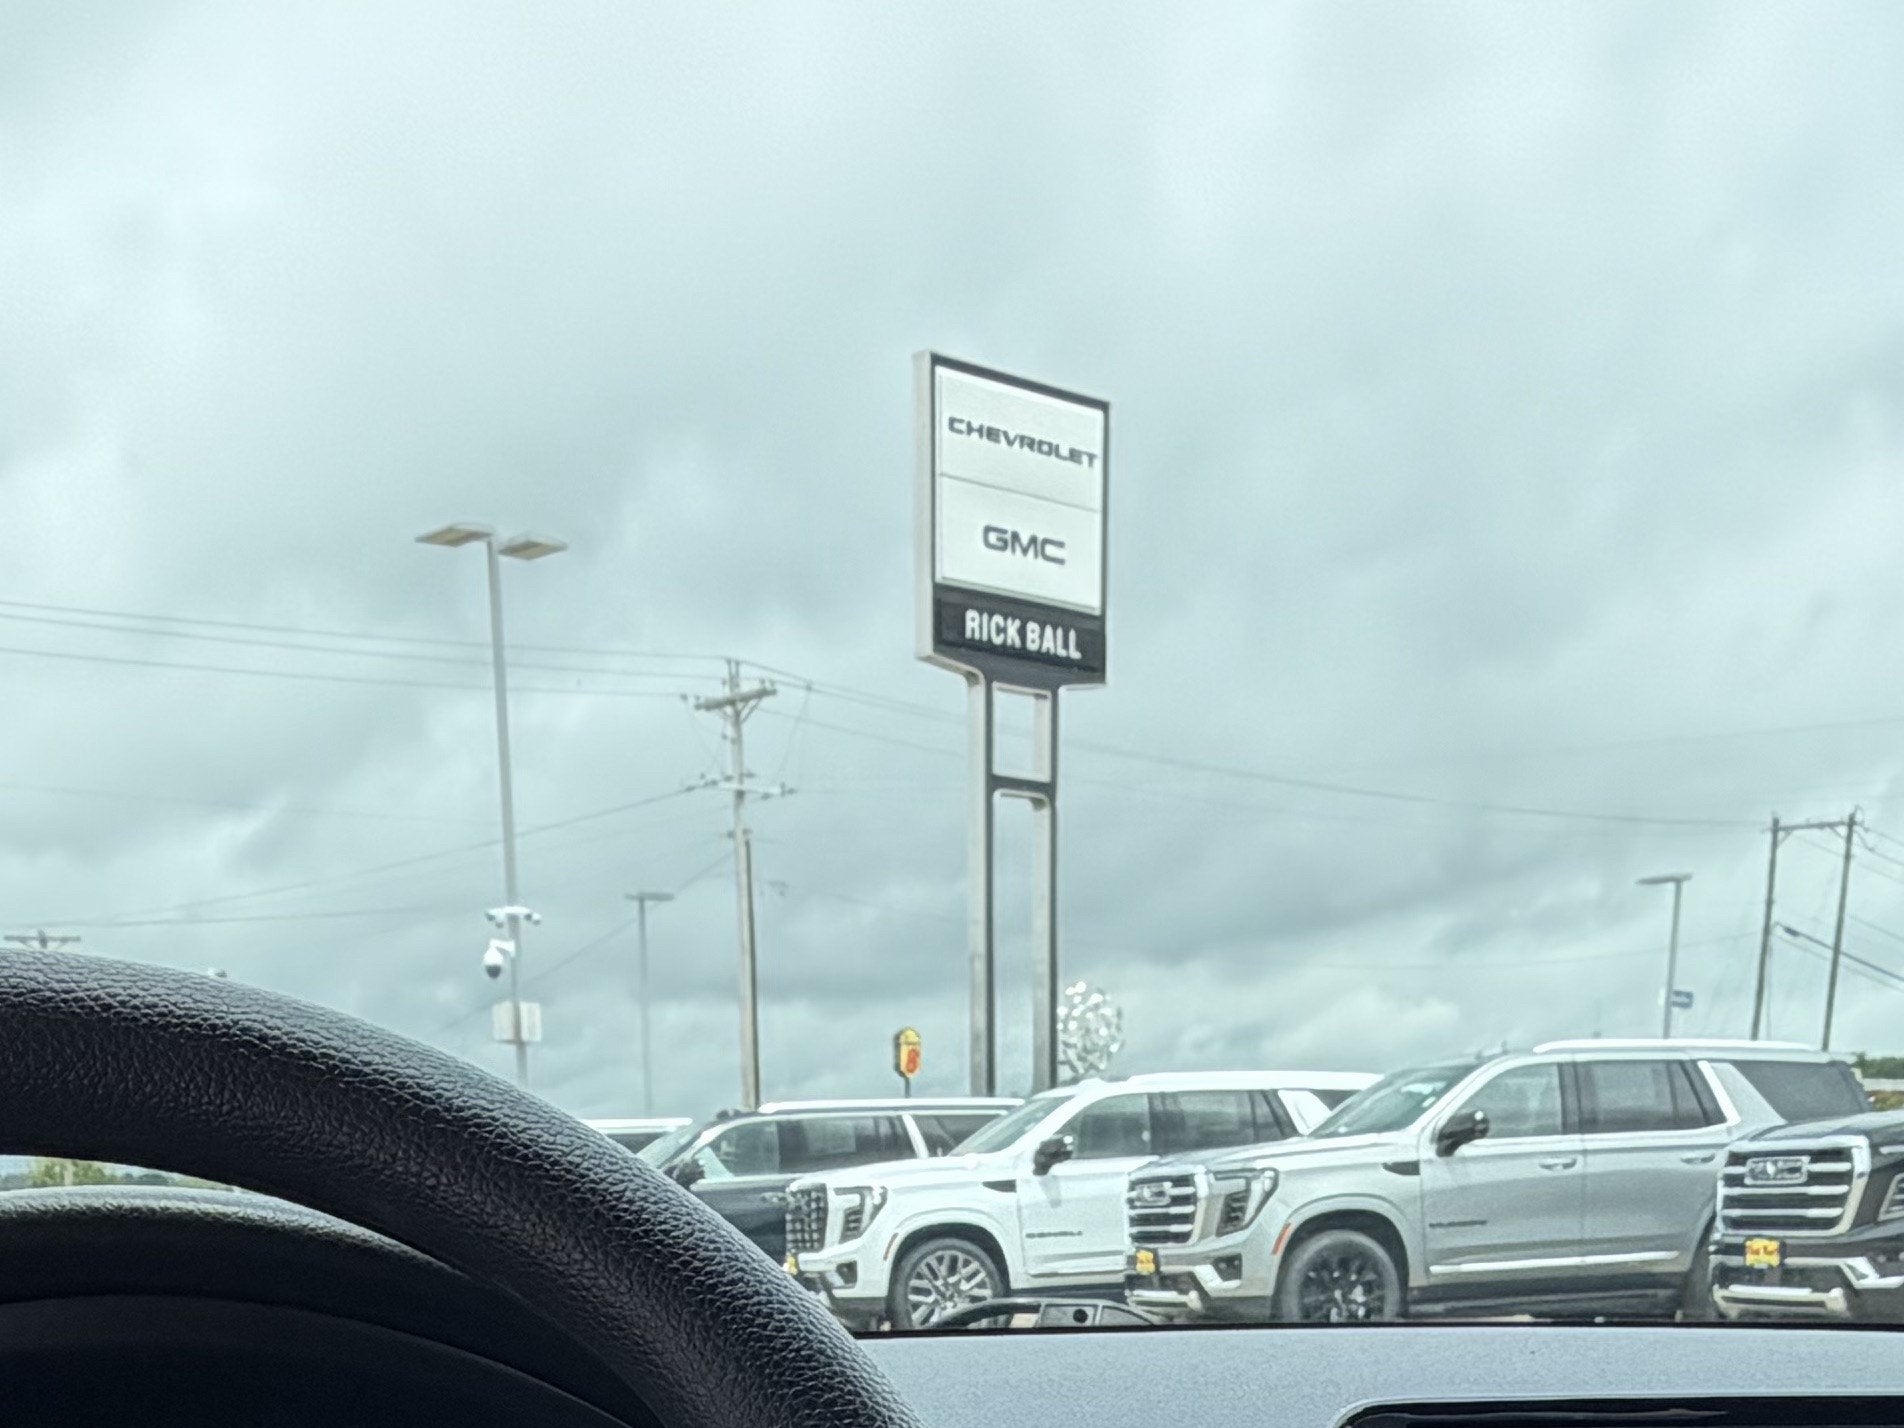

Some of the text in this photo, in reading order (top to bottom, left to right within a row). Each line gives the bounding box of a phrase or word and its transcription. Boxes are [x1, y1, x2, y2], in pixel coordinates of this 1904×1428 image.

[948, 415, 1098, 468] CHEVROLET
[982, 524, 1066, 565] GMC
[964, 608, 1082, 660] RICK BALL
